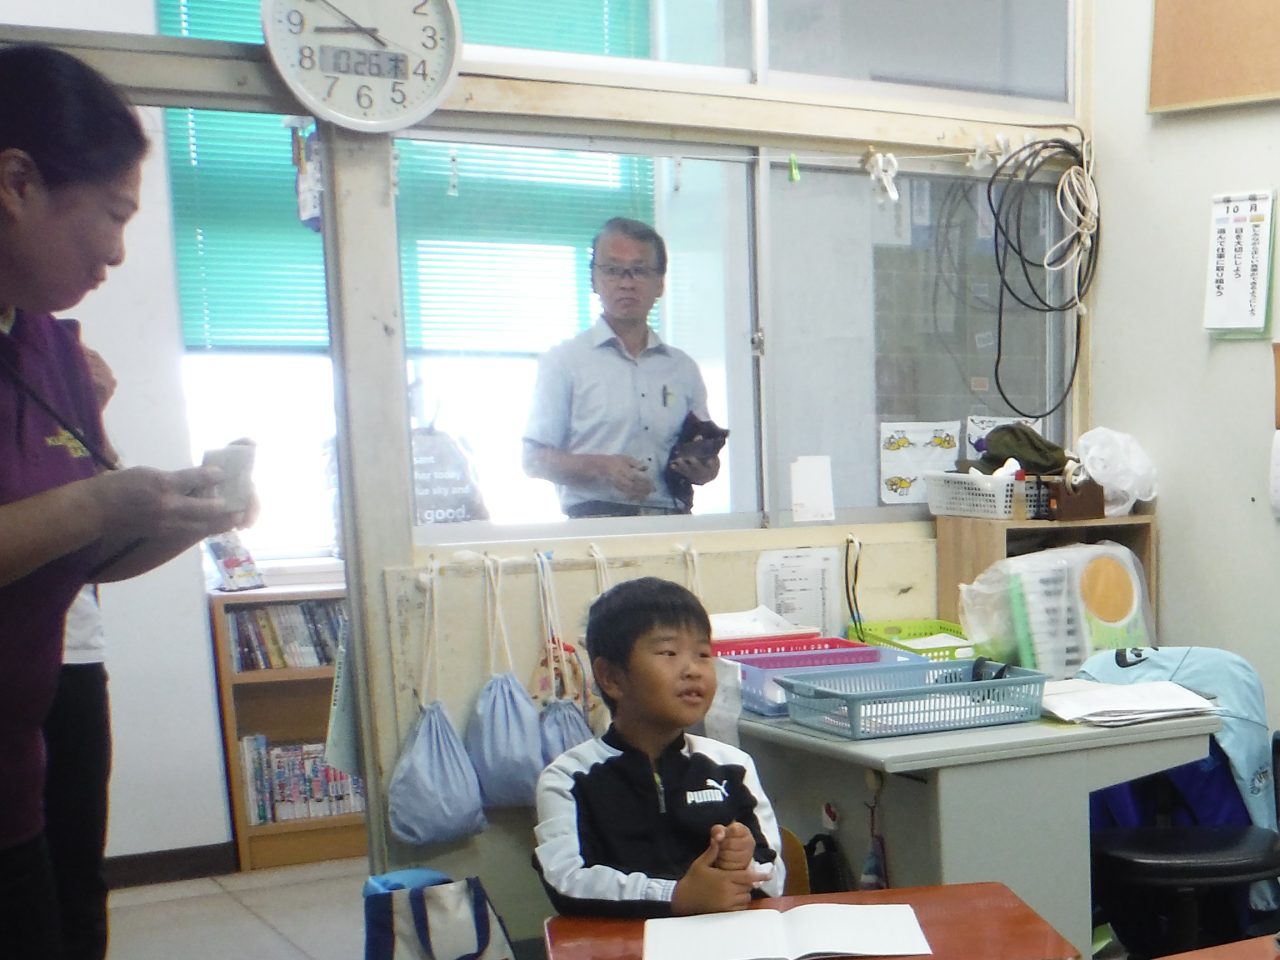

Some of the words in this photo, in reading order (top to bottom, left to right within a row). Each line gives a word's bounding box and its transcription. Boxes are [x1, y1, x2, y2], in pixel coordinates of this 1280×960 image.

[287, 10, 304, 35] 9
[421, 26, 438, 50] 3
[299, 46, 316, 70] 8
[412, 60, 428, 81] 4
[324, 75, 339, 98] 7
[356, 85, 373, 109] 6
[391, 82, 406, 104] 5
[686, 789, 724, 805] PUMA
